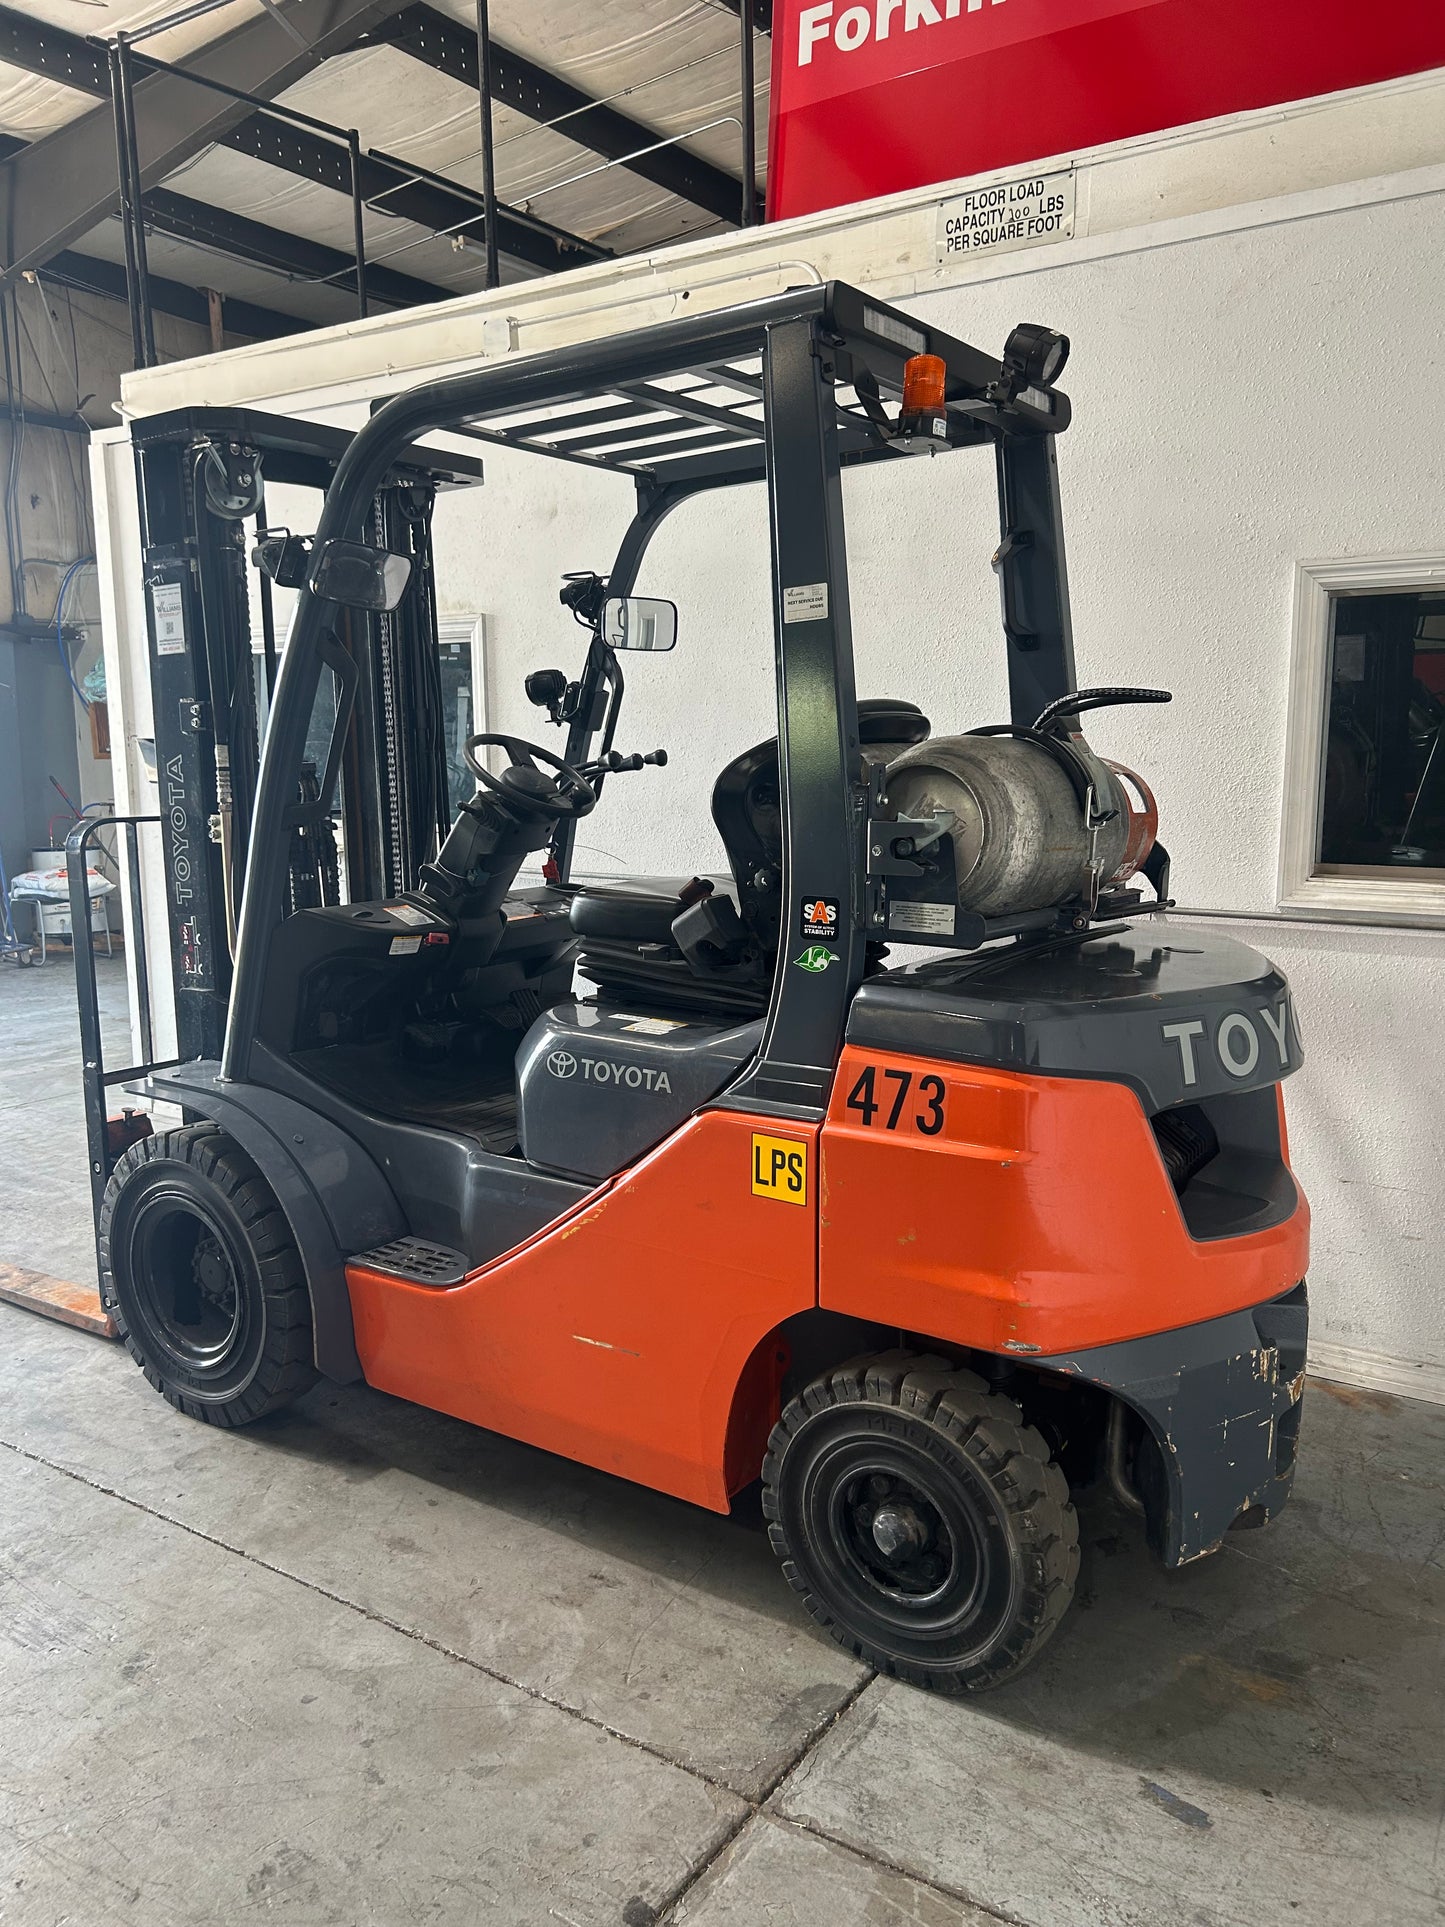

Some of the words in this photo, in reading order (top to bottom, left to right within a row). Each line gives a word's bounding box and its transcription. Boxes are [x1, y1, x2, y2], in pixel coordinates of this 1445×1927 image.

[798, 0, 1007, 67] Fork
[945, 207, 1006, 234] CAPACITY
[1039, 194, 1064, 215] LBS
[965, 188, 1006, 212] FLOOR
[1009, 180, 1045, 203] LOAD
[946, 233, 970, 253] PER
[973, 221, 1024, 247] SQUARE
[1027, 213, 1062, 236] FOOT
[166, 754, 193, 905] TOYOTA
[803, 900, 837, 924] SAS
[804, 928, 835, 936] STABILITY
[1162, 1000, 1304, 1085] TOY
[581, 1058, 672, 1094] TOYOTA
[846, 1065, 946, 1136] 473
[755, 1145, 803, 1193] LPS
